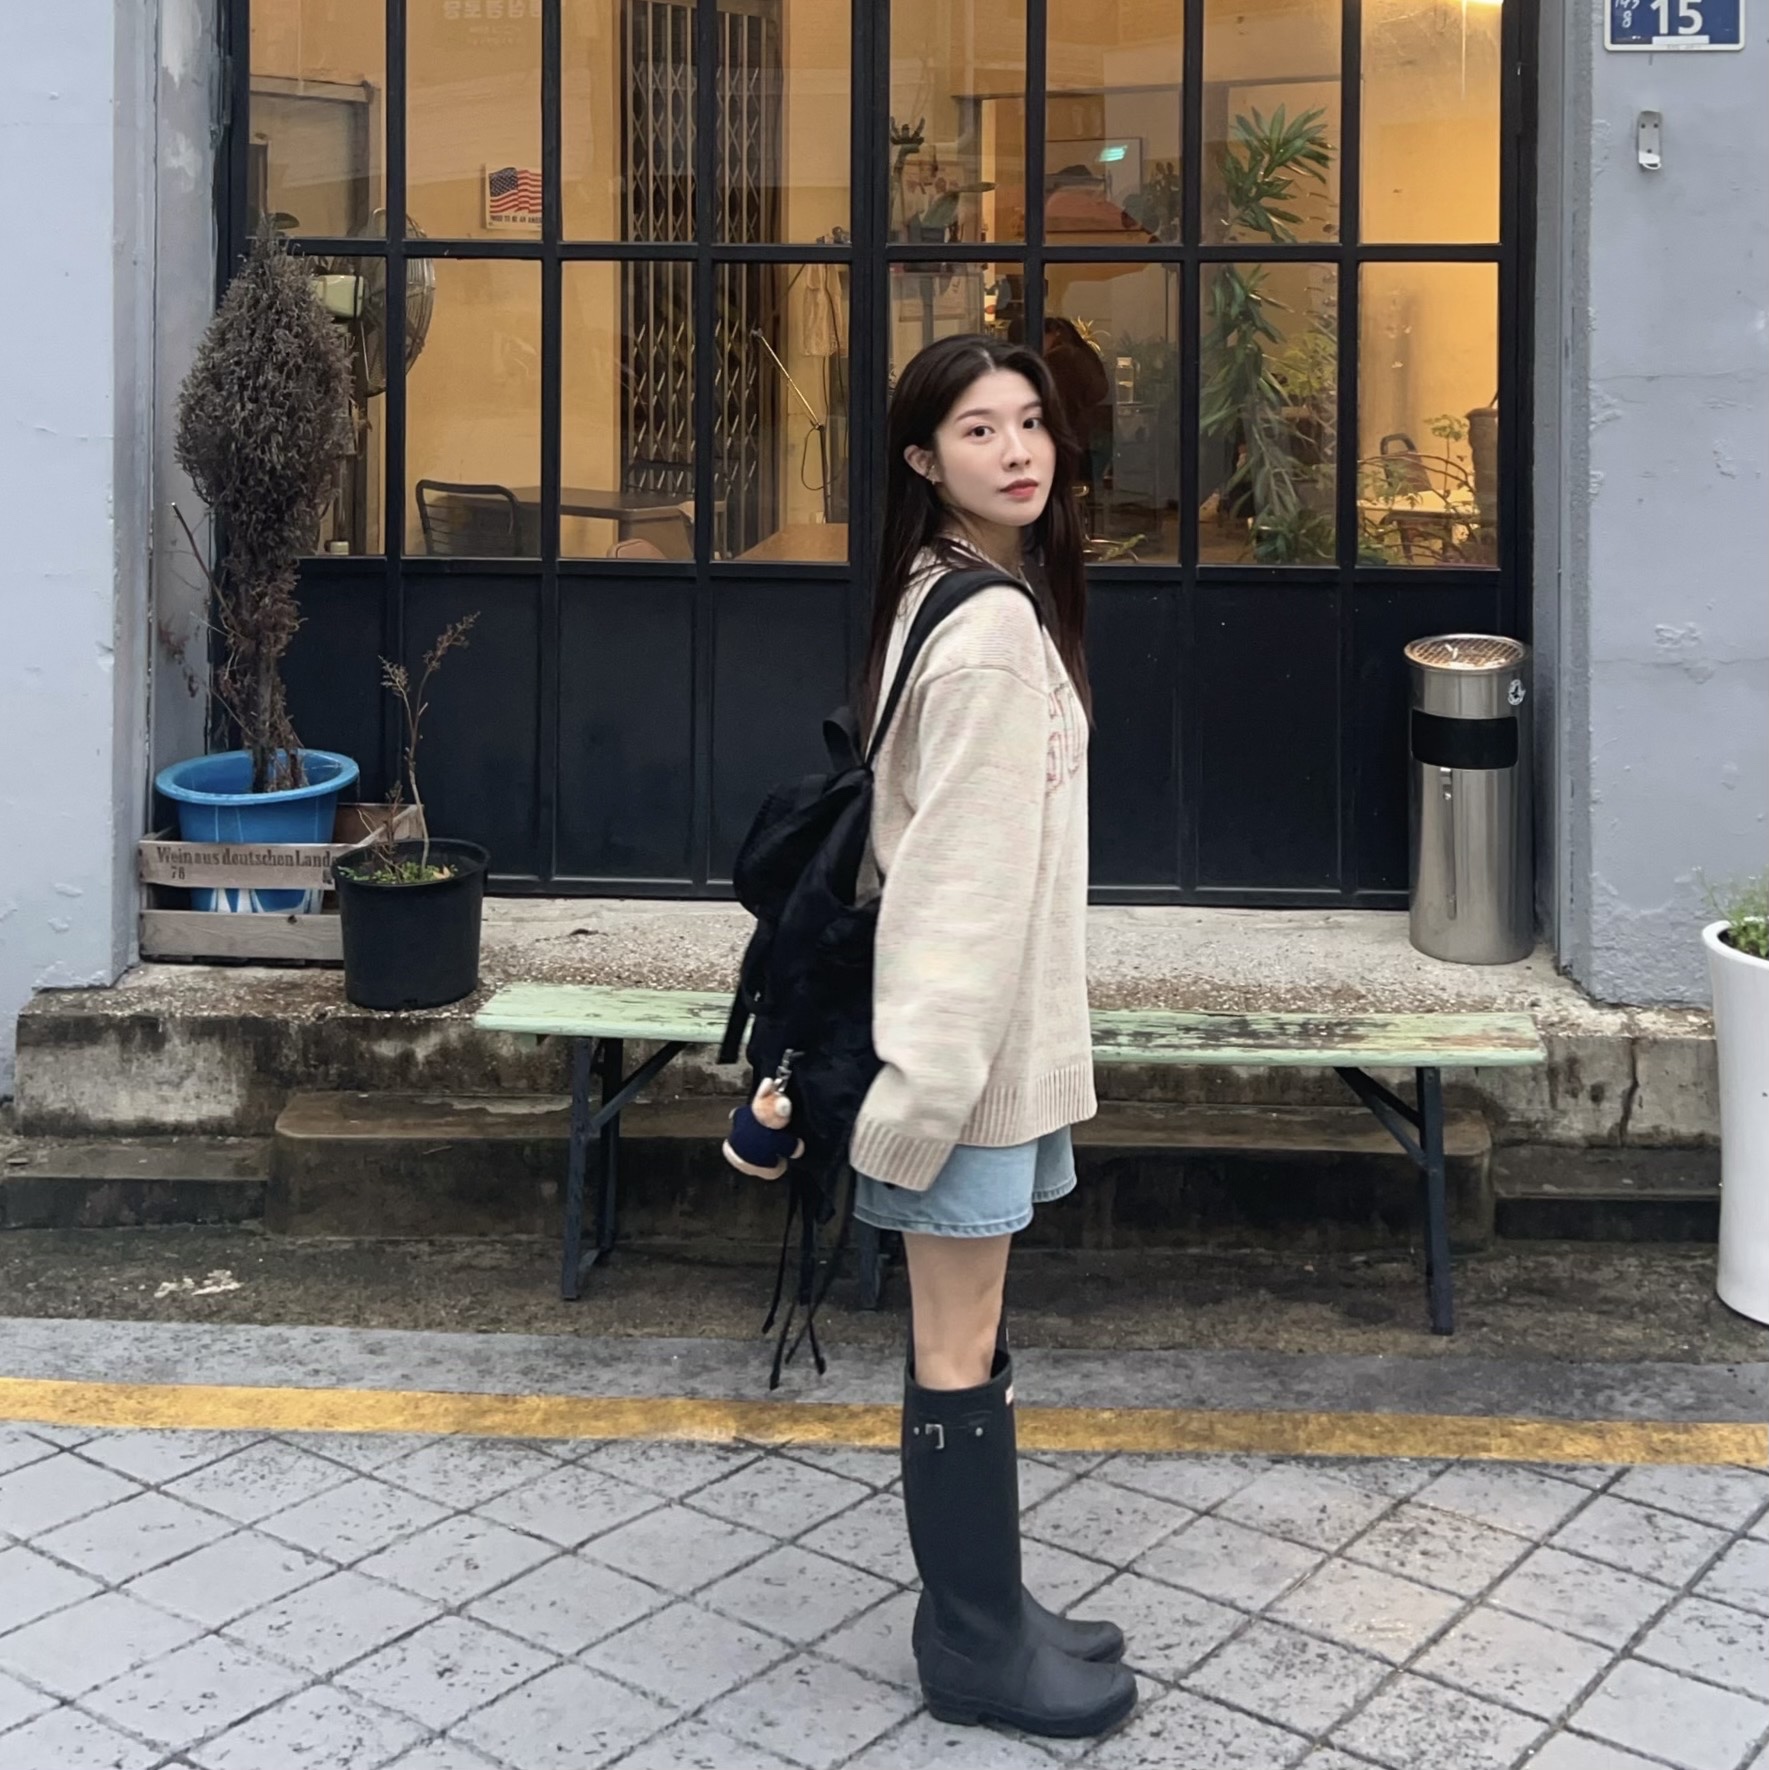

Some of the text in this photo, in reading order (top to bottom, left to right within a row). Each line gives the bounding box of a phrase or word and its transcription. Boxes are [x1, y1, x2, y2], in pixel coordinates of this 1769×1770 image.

[1650, 0, 1703, 35] 15
[157, 846, 194, 866] Wein
[195, 853, 220, 866] aus
